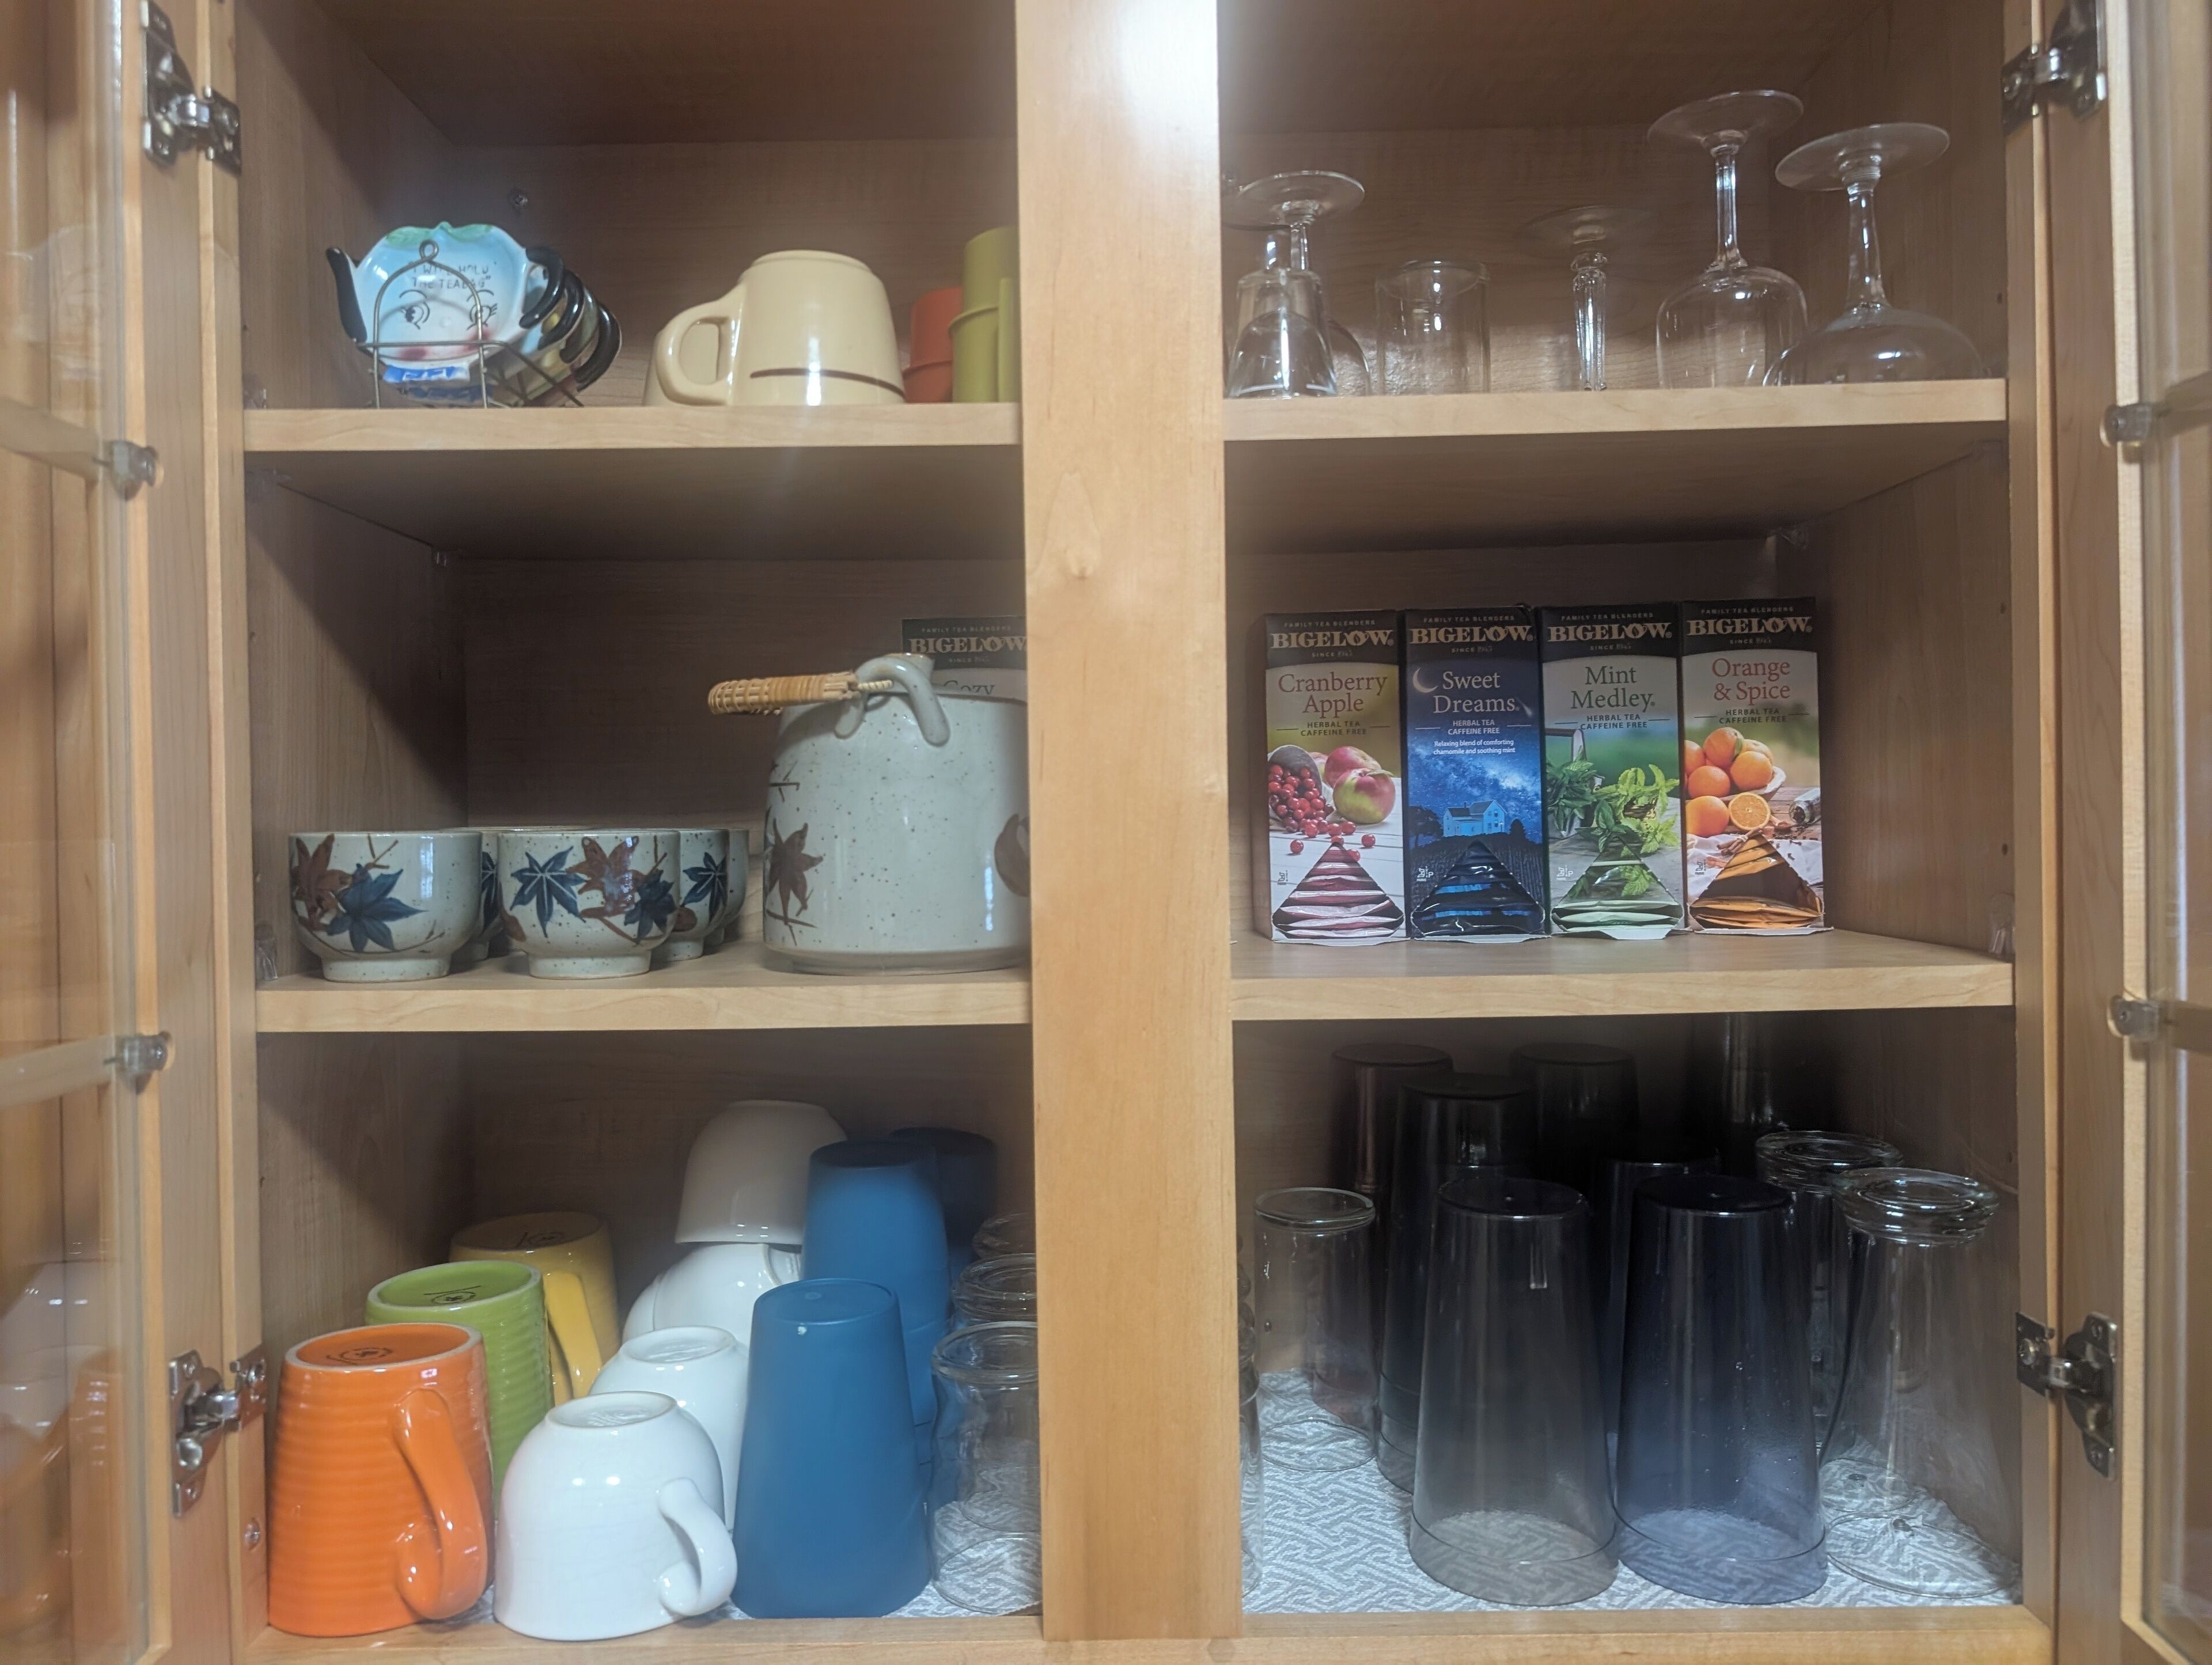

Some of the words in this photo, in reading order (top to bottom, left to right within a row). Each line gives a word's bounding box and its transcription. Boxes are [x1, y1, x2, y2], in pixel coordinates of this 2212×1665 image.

[1442, 671, 1501, 690] Sweet
[1585, 666, 1637, 685] Mint
[1712, 658, 1790, 682] Orange
[1278, 672, 1388, 696] Cranberry
[1714, 683, 1732, 700] &
[1736, 681, 1790, 706] Spice
[1302, 693, 1363, 719] Apple
[1433, 695, 1516, 714] Dreams
[1570, 688, 1653, 713] Medley
[1580, 722, 1624, 730] CAFFEINE
